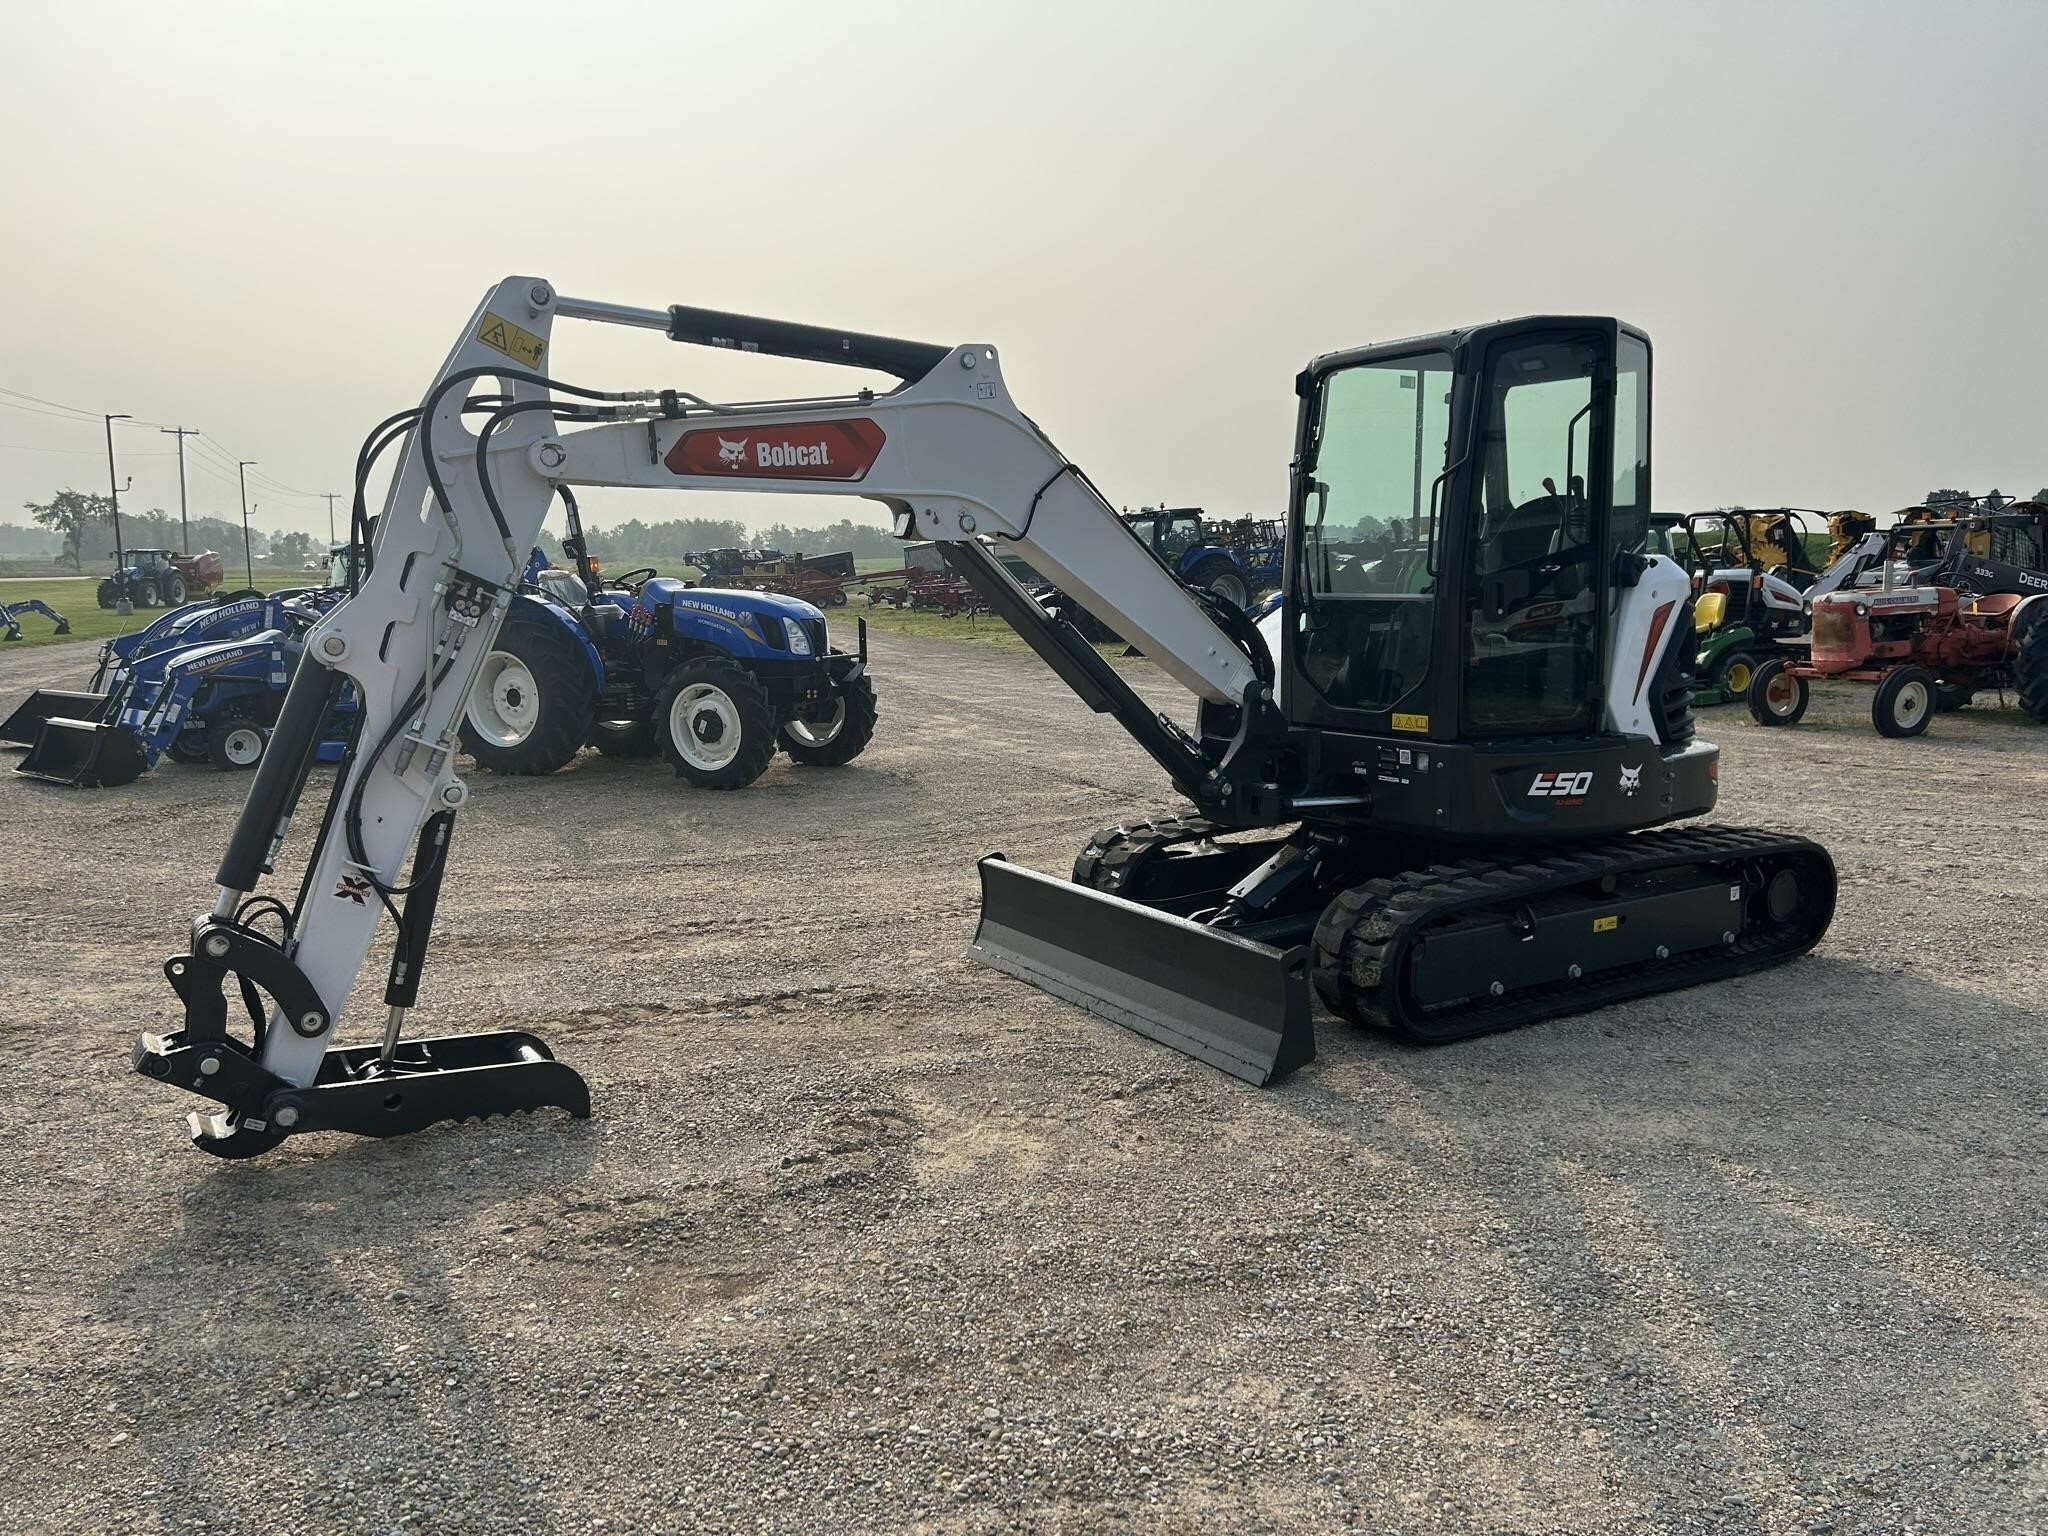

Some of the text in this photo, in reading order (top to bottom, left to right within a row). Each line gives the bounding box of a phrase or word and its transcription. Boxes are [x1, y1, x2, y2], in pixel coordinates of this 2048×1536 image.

[756, 441, 829, 467] Bobcat
[2018, 571, 2048, 590] DEER
[200, 601, 259, 629] NEW HOLLAND
[682, 599, 736, 619] NEW HOLLAND
[187, 649, 243, 671] NEW HOLLAND
[1527, 771, 1594, 796] E50
